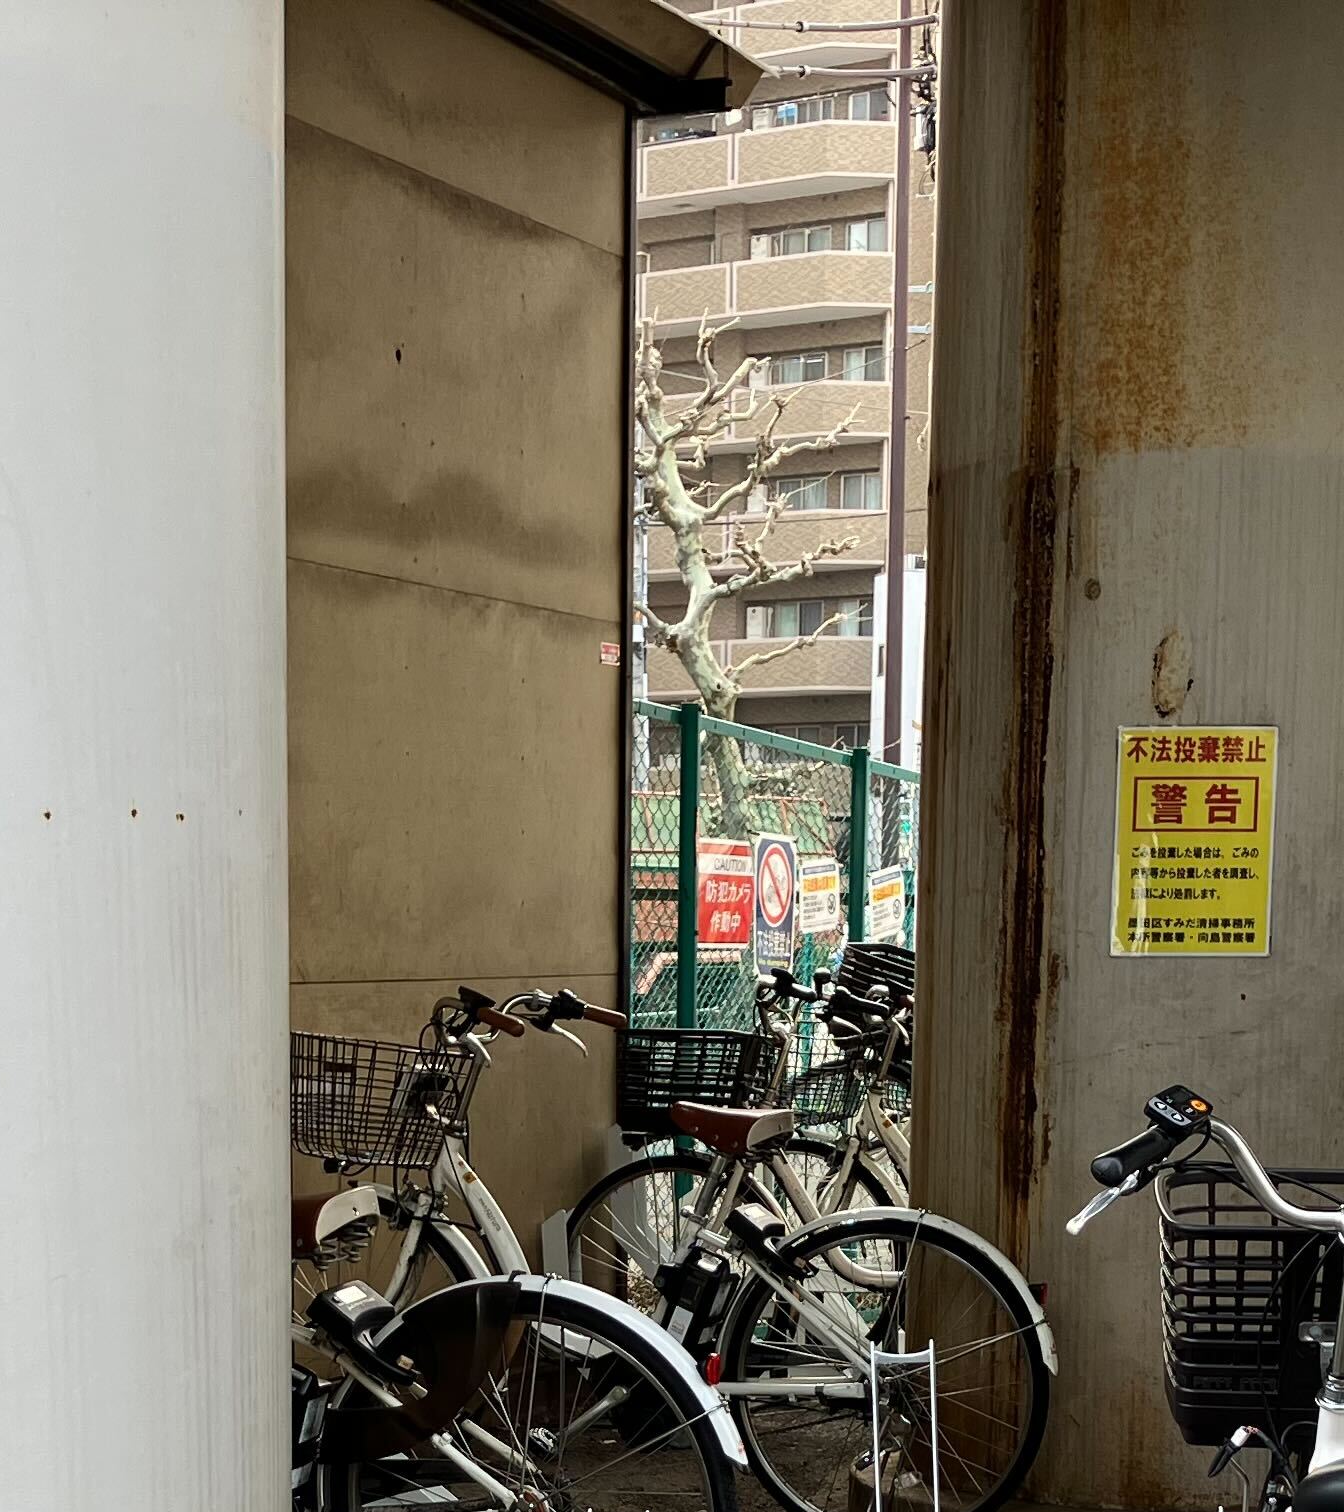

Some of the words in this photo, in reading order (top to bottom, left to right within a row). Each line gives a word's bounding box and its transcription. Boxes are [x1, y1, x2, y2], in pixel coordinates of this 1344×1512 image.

[1126, 736, 1267, 763] 不法投棄禁止
[1151, 783, 1242, 824] 警告
[705, 879, 753, 904] 防犯カメラ
[710, 910, 741, 933] 作動中
